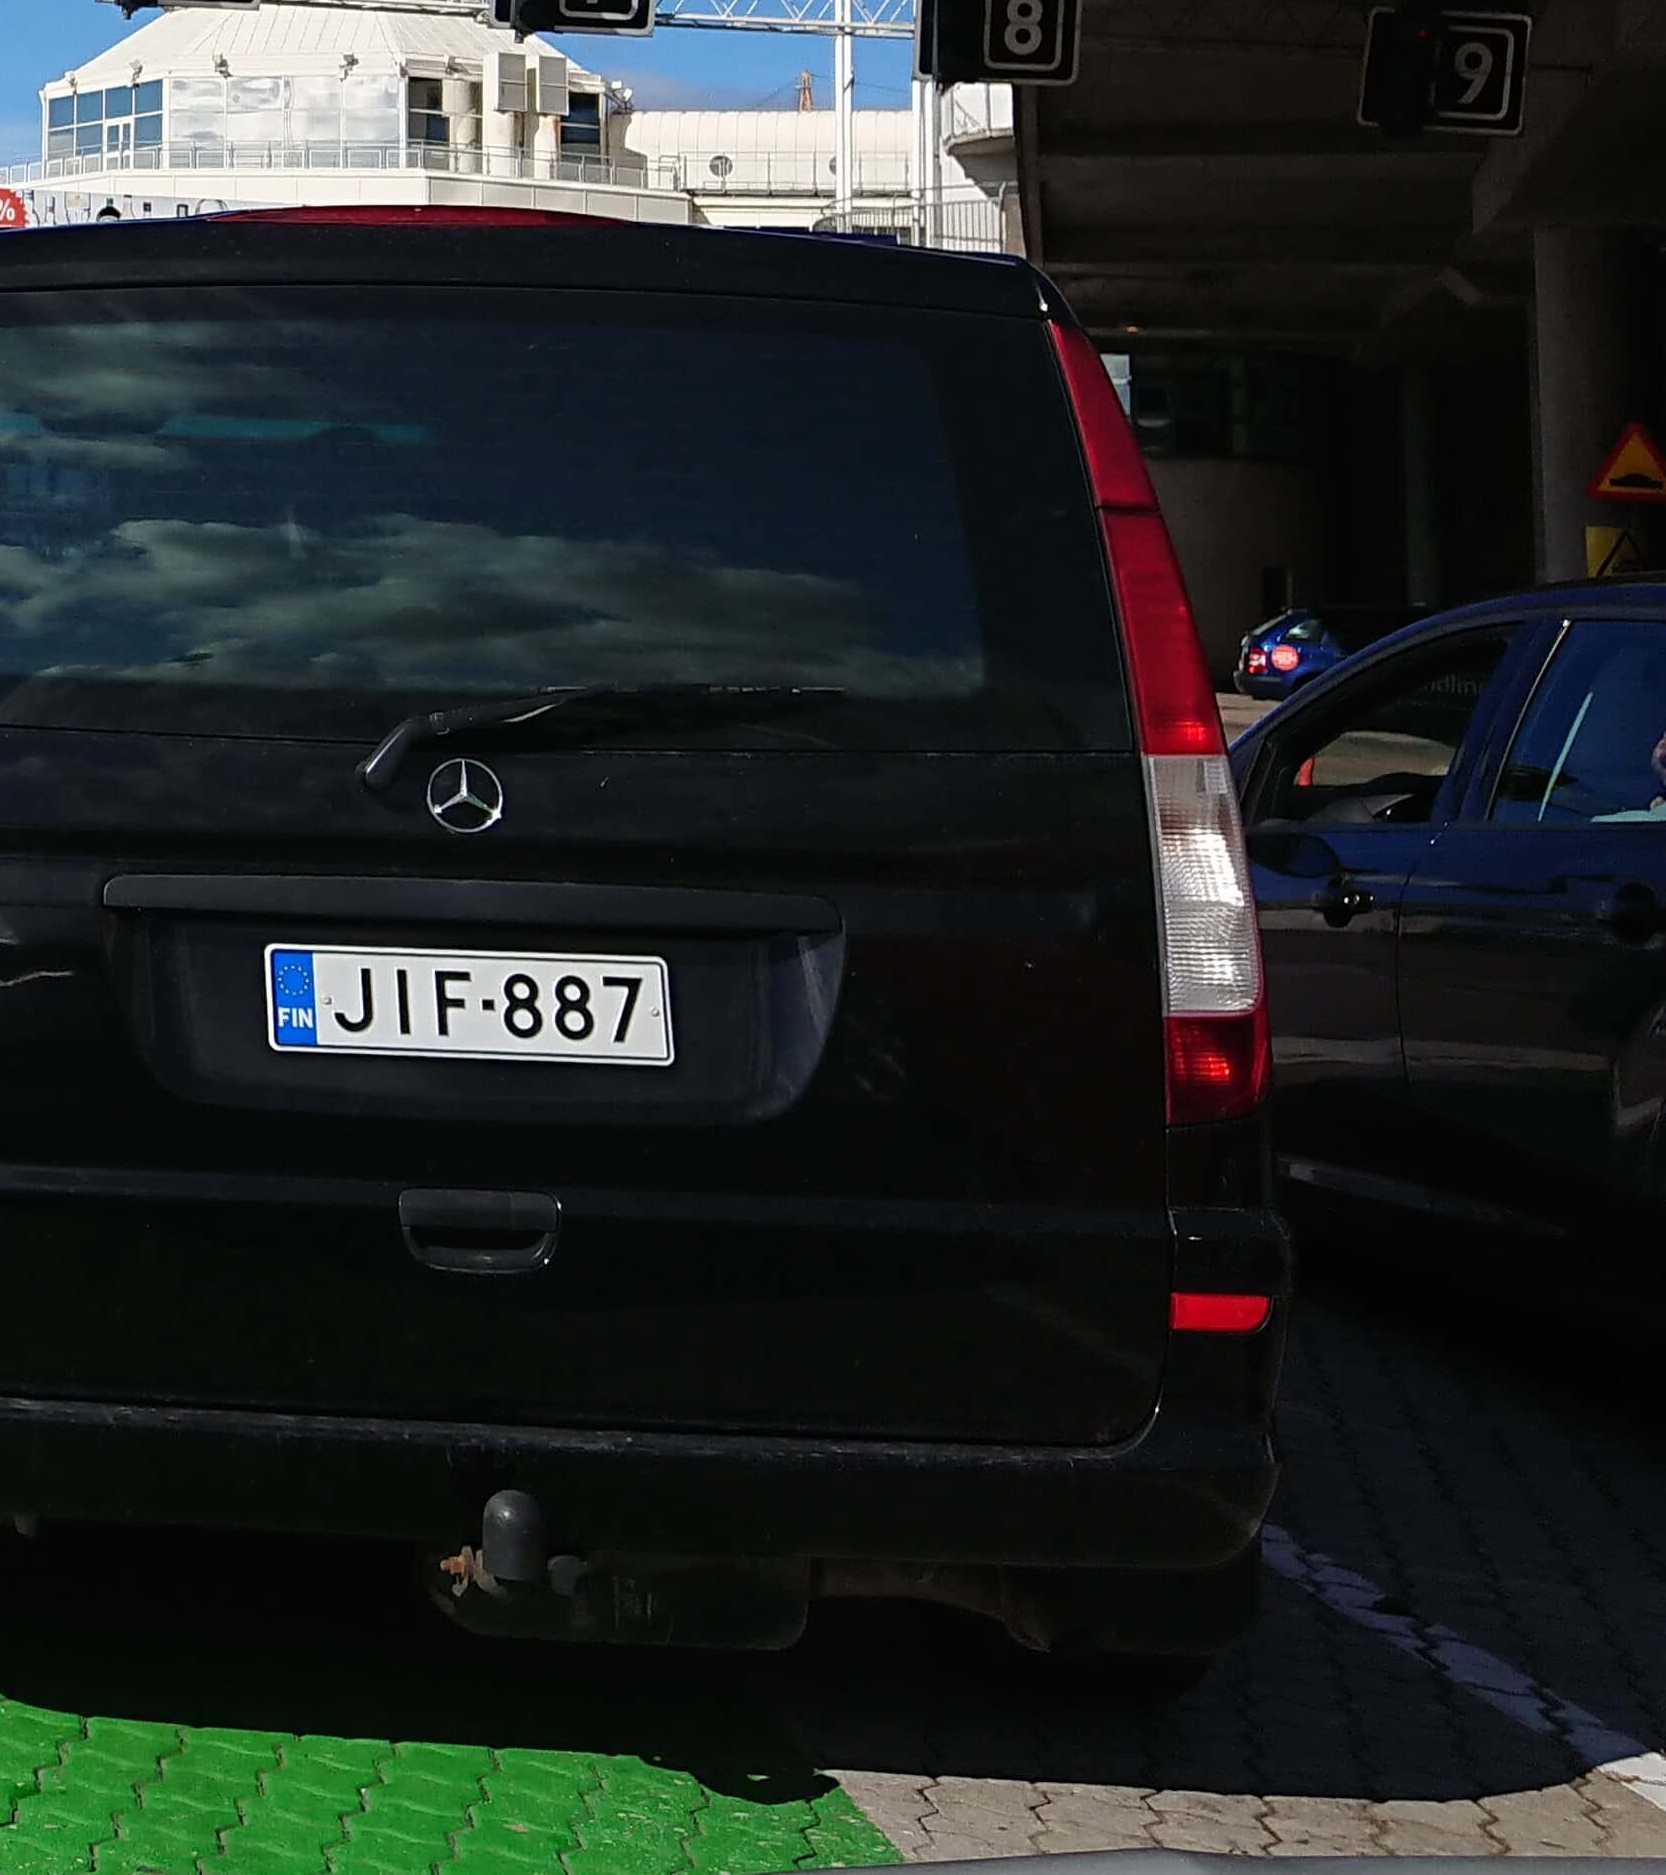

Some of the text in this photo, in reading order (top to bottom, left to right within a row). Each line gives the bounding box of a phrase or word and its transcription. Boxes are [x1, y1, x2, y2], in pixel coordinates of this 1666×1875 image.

[1455, 42, 1493, 104] 9
[277, 1006, 314, 1029] FIN
[334, 967, 643, 1043] JIF-887
